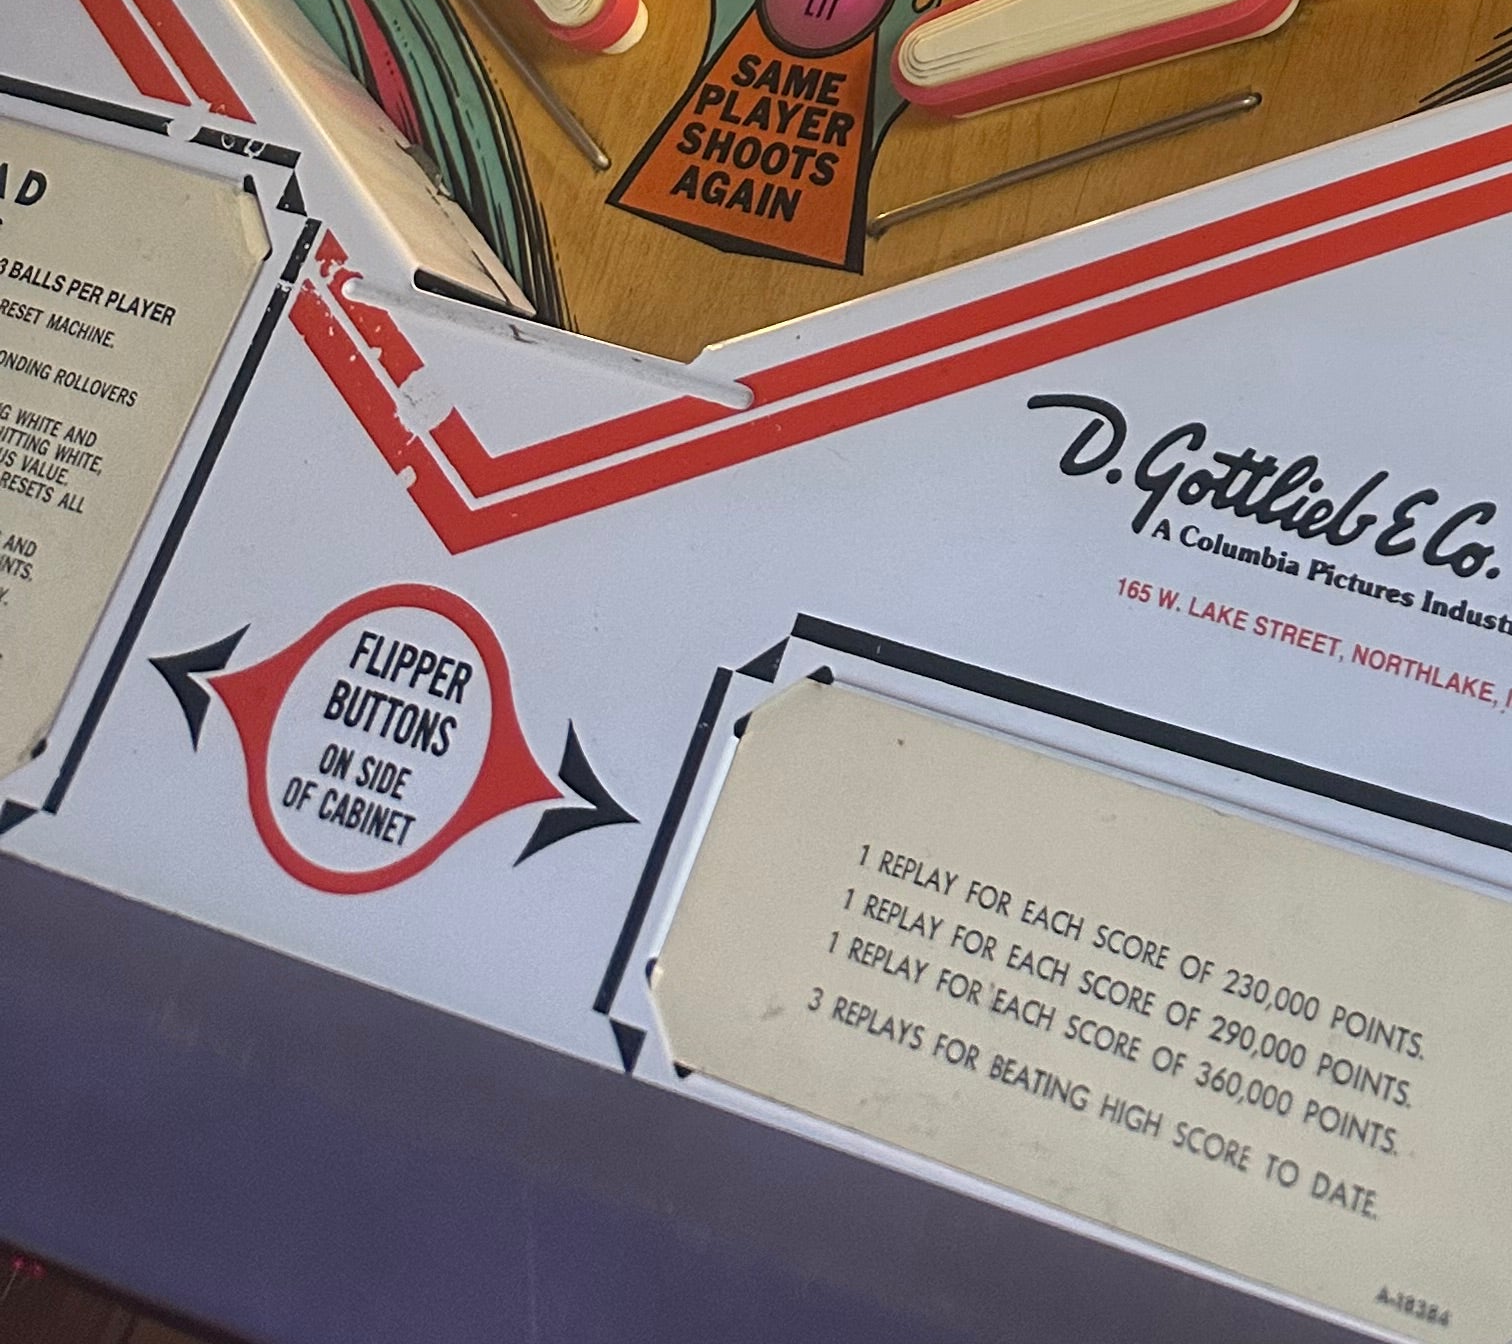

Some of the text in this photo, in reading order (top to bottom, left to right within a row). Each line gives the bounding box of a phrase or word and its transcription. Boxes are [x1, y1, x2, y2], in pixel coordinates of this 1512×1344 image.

[731, 53, 848, 107] SAME
[693, 82, 856, 148] PLAYER
[675, 121, 840, 187] SHOOTS
[669, 164, 803, 223] AGAIN
[0, 297, 117, 350] RESET MACHINE.
[8, 260, 67, 294] BALLS
[65, 278, 105, 306] PER
[104, 289, 178, 327] PLAYER
[53, 368, 139, 409] ROLLOVERS
[15, 407, 64, 439] WHITE
[63, 425, 98, 449] AND
[54, 442, 104, 477] WHITE,
[0, 470, 87, 514] RESETS ALL
[21, 453, 71, 487] VALUE.
[1026, 392, 1128, 486] D.
[1130, 420, 1391, 548] Gottlieb
[1421, 500, 1502, 580] Co.
[2, 533, 38, 558] AND
[1151, 517, 1172, 541] A
[1179, 523, 1301, 577] Columbia
[1306, 557, 1416, 609] Pictures
[348, 629, 474, 705] FLIPPER
[1116, 576, 1154, 604] 165
[1157, 587, 1182, 613] W.
[1187, 596, 1251, 632] LAKE
[1252, 614, 1345, 663] STREET,
[1350, 642, 1499, 709] NORTHLAKE,
[322, 678, 458, 759] BUTTONS
[318, 742, 414, 801] ON SIDE
[281, 775, 418, 847] OF CABINET
[858, 843, 1426, 1062] 1 REPLAY FOR EACH SCORE OF 230,000 POINTS.
[842, 887, 1413, 1110] 1 REPLAY FOR EACH SCORE OF 290,000 POINTS.
[827, 929, 1399, 1158] 1 REPLAY FOR EACH SCORE OF 360,000 POINTS.
[806, 986, 1379, 1222] 3 REPLAYS FOR BEATING HIGH SCORE TO DATE.
